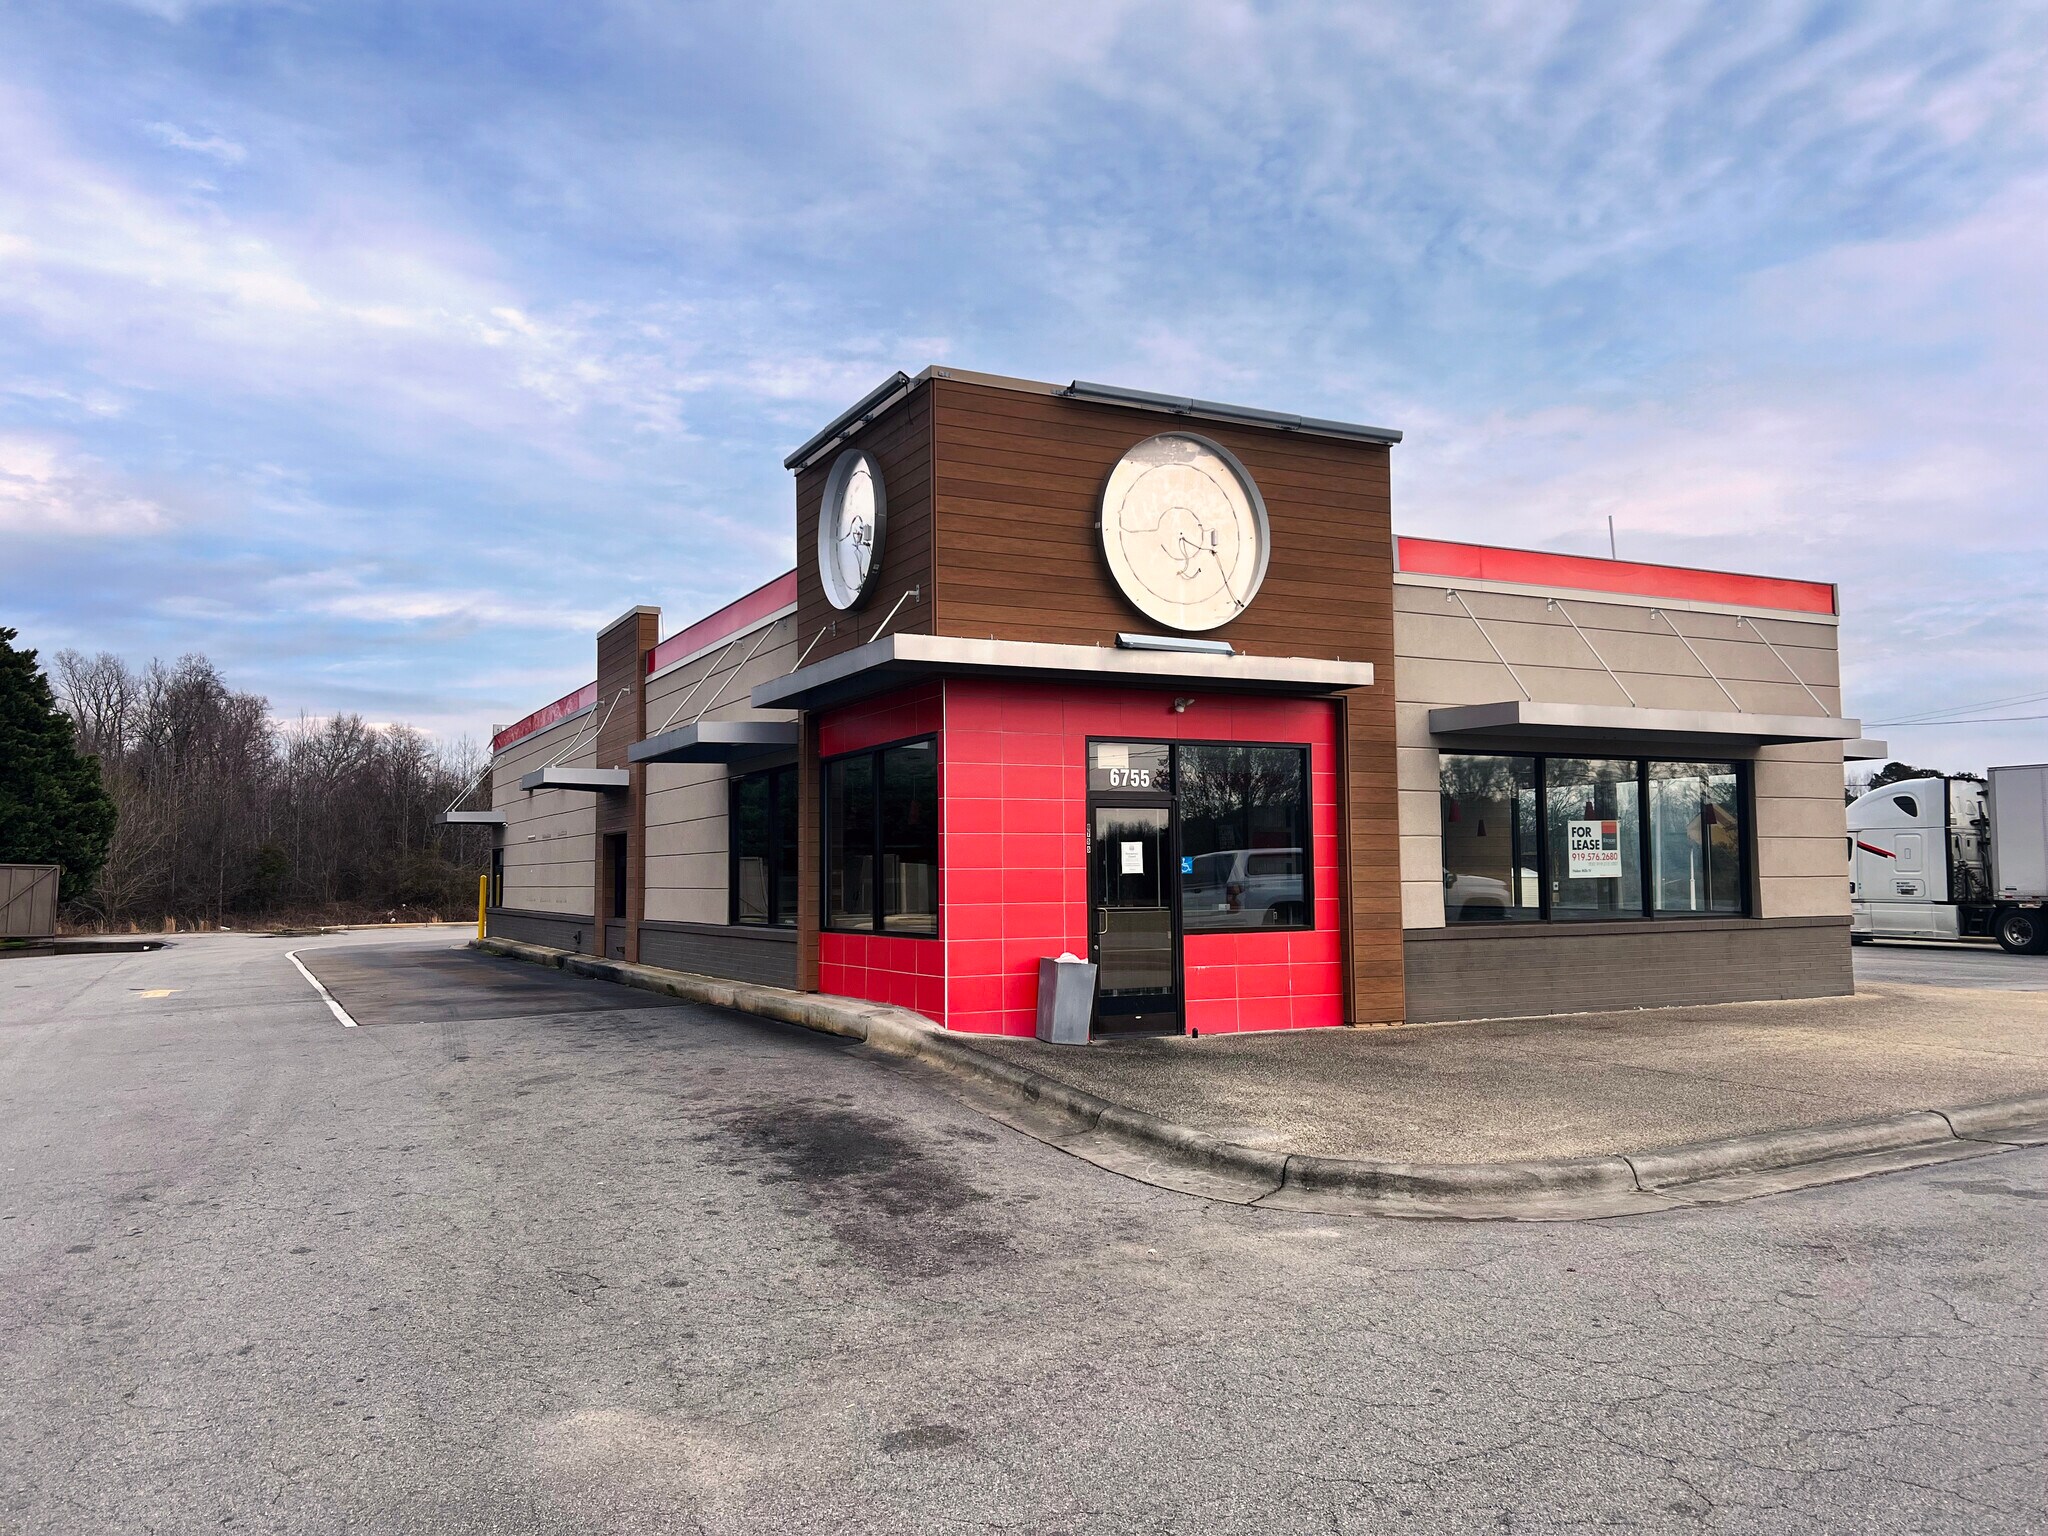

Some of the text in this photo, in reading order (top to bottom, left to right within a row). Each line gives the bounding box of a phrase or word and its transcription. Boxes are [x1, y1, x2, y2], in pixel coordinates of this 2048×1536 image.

[1110, 768, 1150, 787] 6755
[1572, 827, 1592, 838] FOR
[1572, 840, 1600, 850] LEASE
[1572, 852, 1618, 861] 919.576.2680
